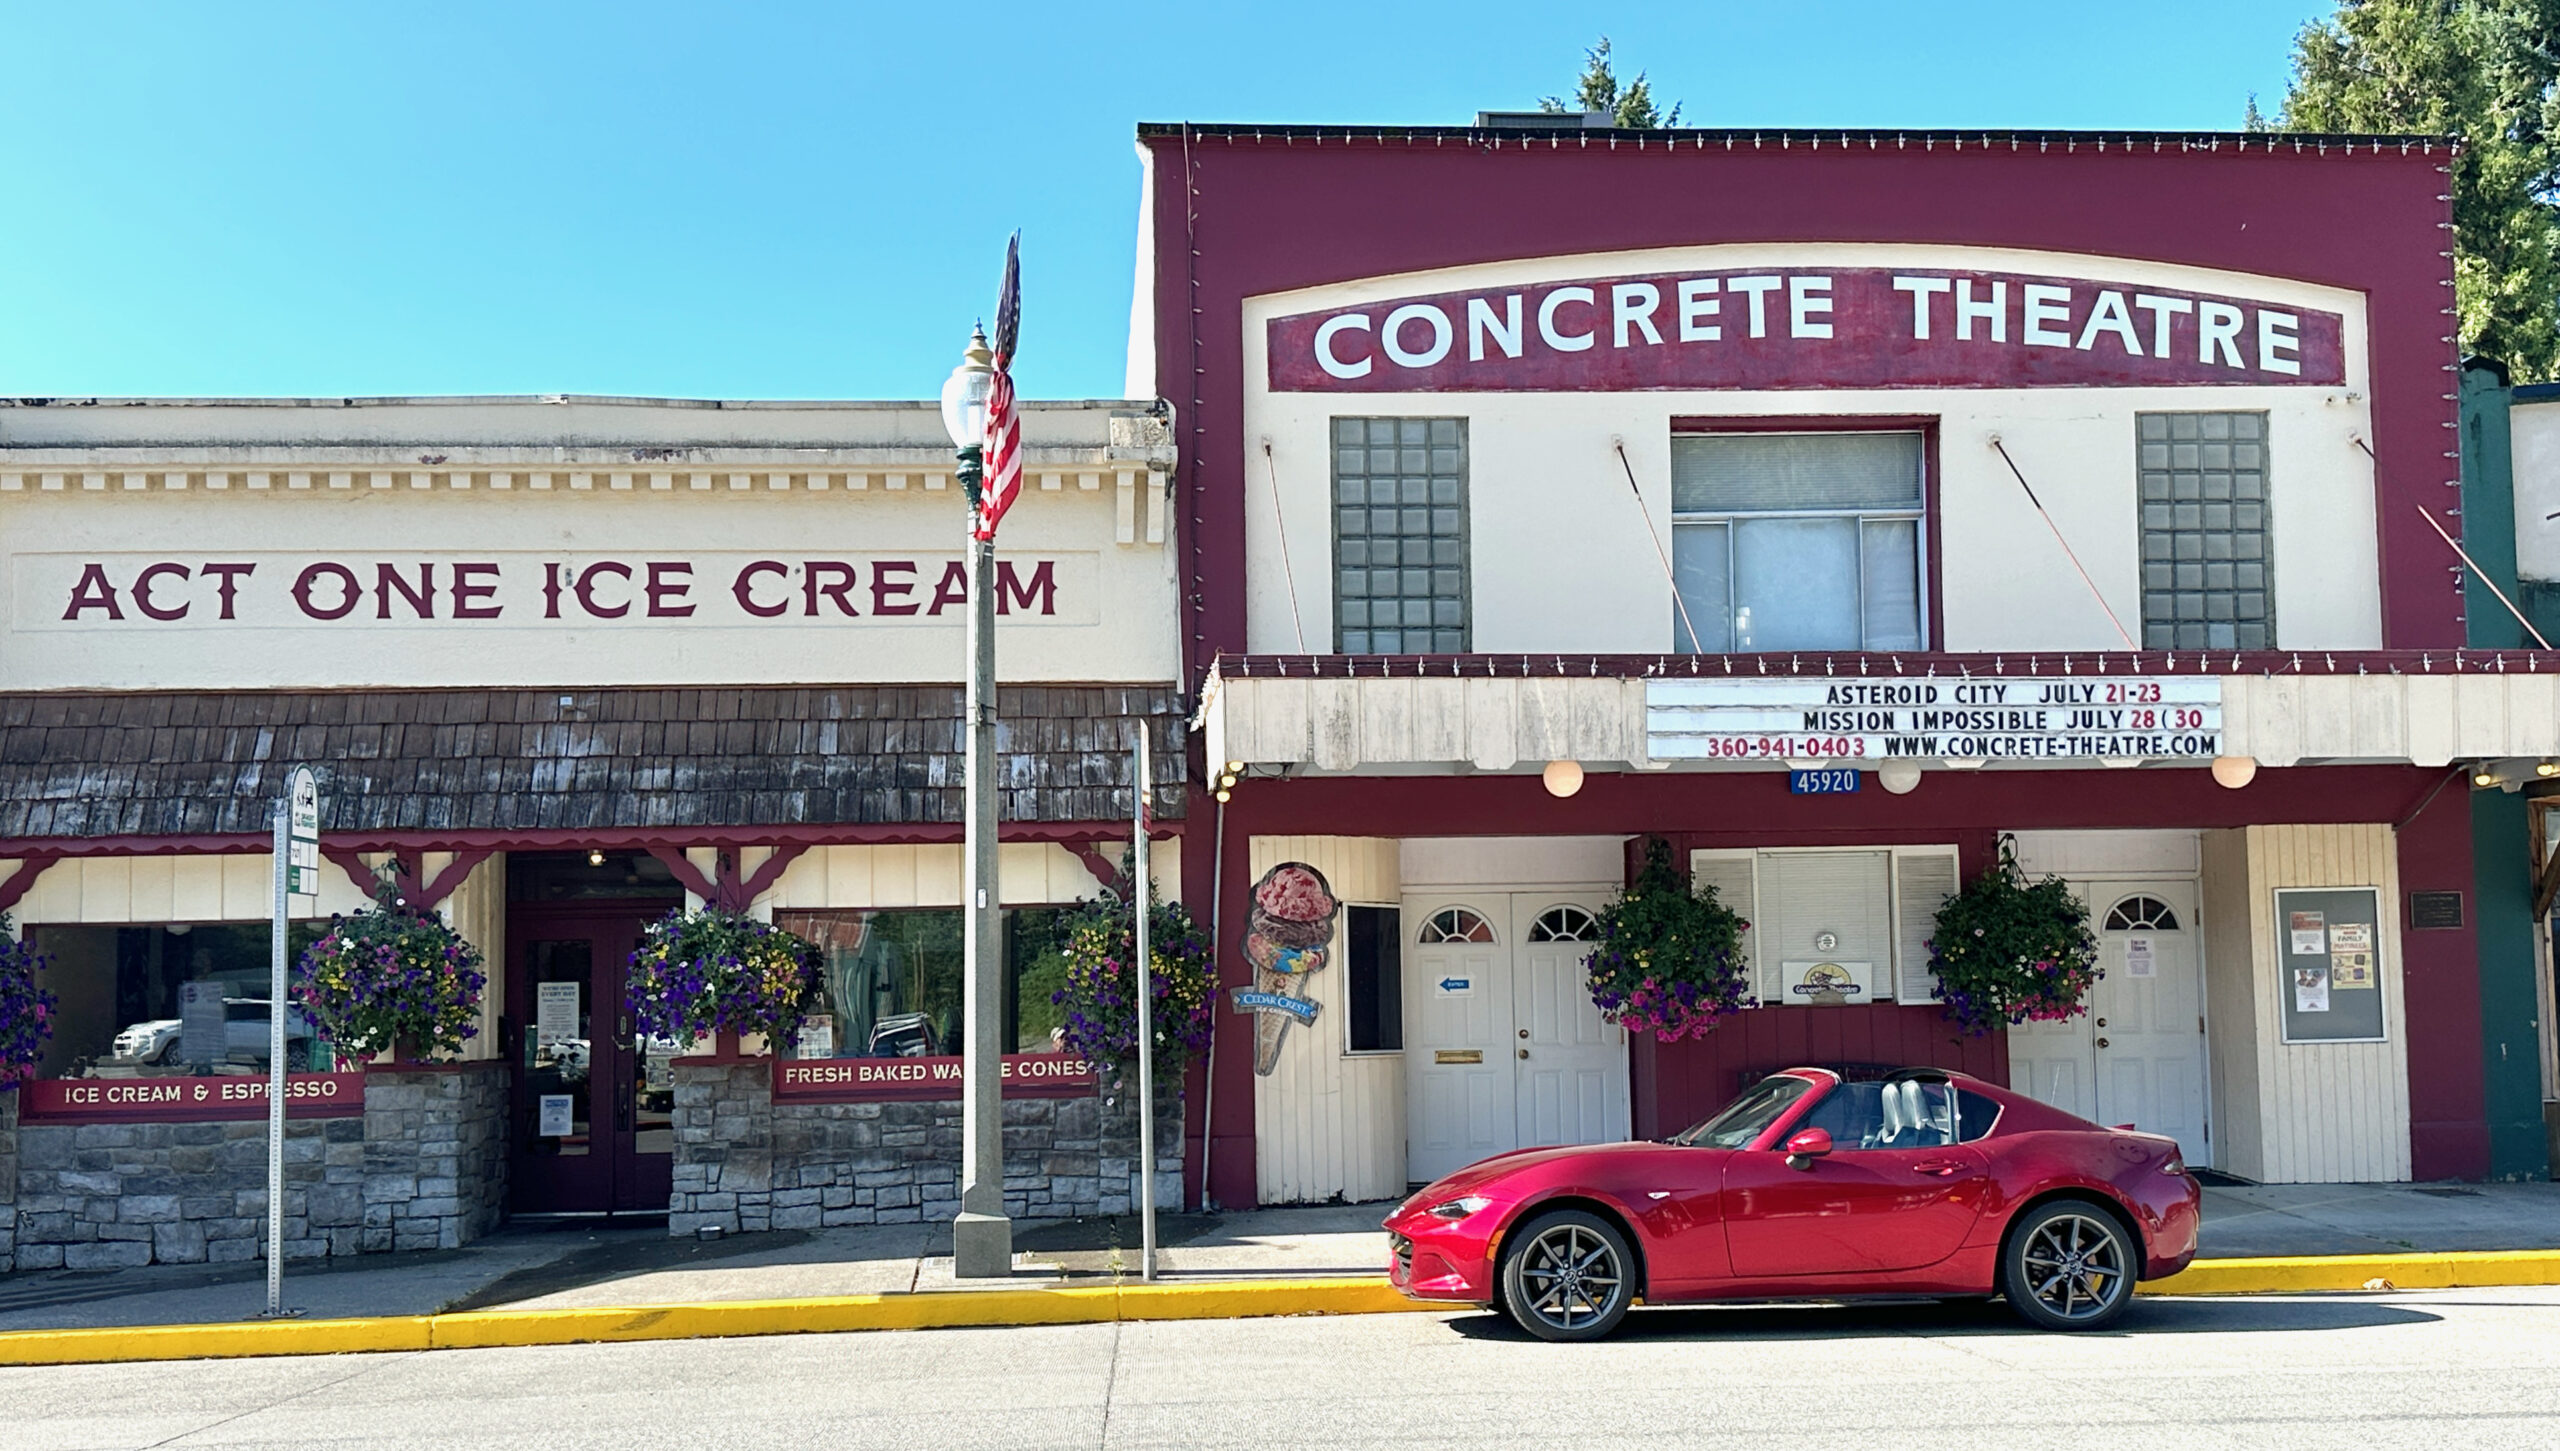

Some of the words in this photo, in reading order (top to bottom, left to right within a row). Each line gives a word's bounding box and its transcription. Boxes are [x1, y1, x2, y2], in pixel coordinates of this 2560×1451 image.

[1313, 275, 1835, 379] CONCRETE
[1892, 276, 2301, 376] THEATRE
[61, 562, 257, 620] ACT
[291, 562, 503, 619] ONE
[542, 561, 696, 618] ICE
[731, 561, 1058, 617] CREAM
[1826, 685, 1938, 704] ASTEROID
[1955, 685, 2008, 704] CITY
[2039, 684, 2096, 703] JULY
[2105, 684, 2162, 703] 21-23
[1803, 711, 1896, 731] MISSION
[1911, 711, 2048, 730] IMPOSSIBLE
[2066, 711, 2123, 729] JULY
[1707, 737, 1866, 757] 360-941-0403
[1884, 736, 2216, 756] WWW.CONCRETE-THEATRE.COM
[1797, 771, 1854, 792] 45920
[1243, 993, 1277, 1005] CEDAR
[1277, 997, 1308, 1014] CREST
[786, 1066, 852, 1084] FRESH
[858, 1065, 927, 1082] BAKED
[1018, 1060, 1088, 1077] CONES
[65, 1087, 100, 1104] ICE
[106, 1085, 182, 1102] CREAM
[193, 1084, 209, 1102] &
